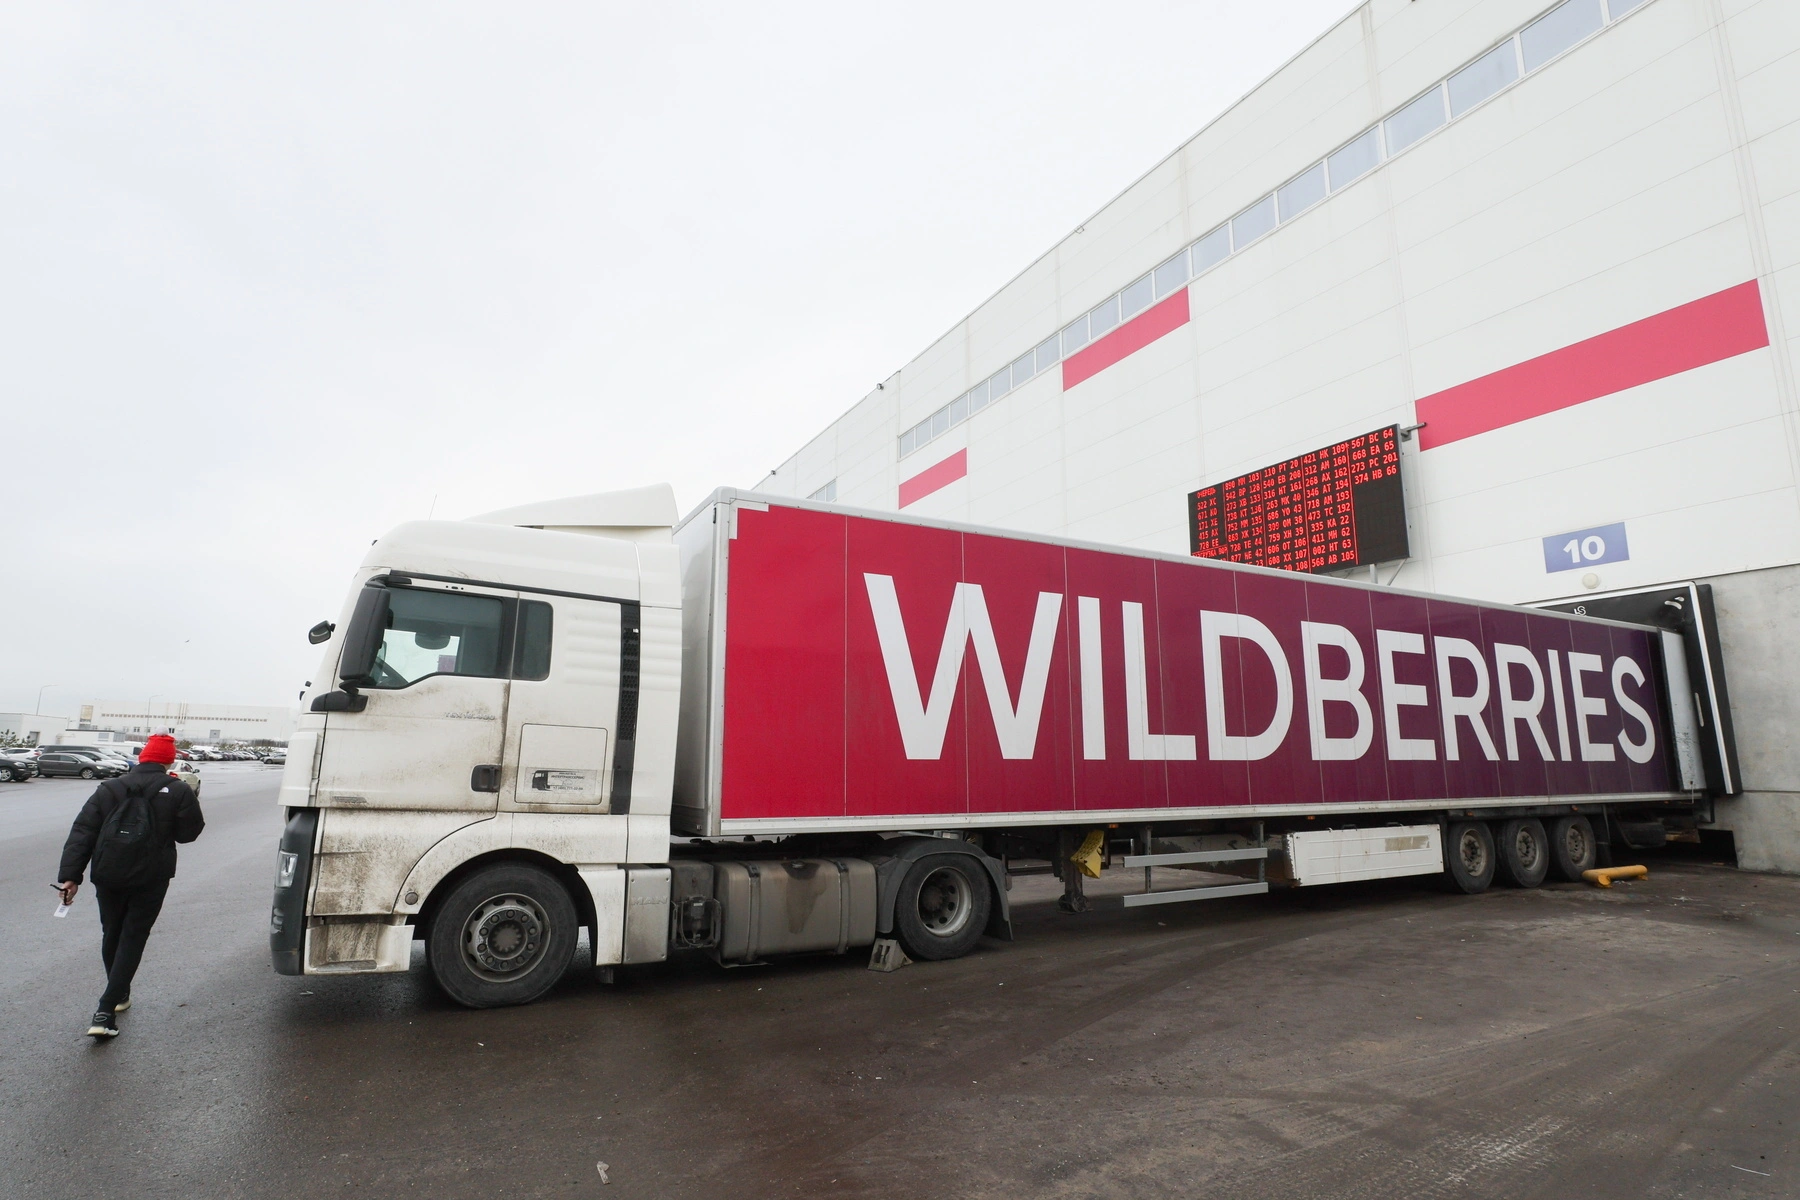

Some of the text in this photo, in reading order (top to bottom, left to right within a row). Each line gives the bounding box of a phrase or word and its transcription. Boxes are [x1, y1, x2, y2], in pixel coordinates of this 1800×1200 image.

[1352, 437, 1364, 449] 567
[1383, 428, 1393, 439] 64
[1304, 454, 1316, 464] 421
[1352, 449, 1366, 460] 668
[1384, 441, 1394, 451] 65
[1264, 467, 1276, 478] 110
[1290, 460, 1298, 469] 20
[1305, 465, 1317, 476] 312
[1334, 455, 1347, 466] 160
[1351, 462, 1365, 473] 273
[1383, 452, 1398, 464] 201
[1248, 472, 1259, 483] 103
[1263, 478, 1274, 489] 540
[1290, 470, 1301, 481] 208
[1305, 477, 1318, 487] 268
[1334, 467, 1348, 478] 162
[1355, 472, 1368, 484] 374
[1387, 465, 1396, 475] 66
[1226, 491, 1236, 501] 542
[1249, 483, 1260, 494] 128
[1264, 489, 1275, 500] 316
[1290, 481, 1302, 492] 161
[1307, 488, 1319, 498] 346
[1335, 479, 1349, 489] 194
[1198, 501, 1207, 510] 522
[1226, 502, 1236, 511] 273
[1250, 494, 1261, 504] 133
[1266, 500, 1278, 510] 263
[1293, 493, 1301, 502] 40
[1307, 499, 1320, 510] 718
[1336, 491, 1350, 502] 193
[1198, 511, 1208, 520] 671
[1250, 504, 1262, 515] 136
[1268, 510, 1279, 521] 686
[1294, 504, 1302, 513] 43
[1308, 511, 1321, 521] 473
[1337, 503, 1351, 513] 192
[1199, 521, 1208, 530] 171
[1228, 522, 1238, 532] 752
[1251, 515, 1262, 526] 135
[1294, 515, 1303, 524] 38
[1311, 522, 1324, 532] 335
[1340, 515, 1349, 525] 22
[1199, 531, 1208, 540] 415
[1252, 526, 1262, 536] 134
[1269, 533, 1280, 543] 759
[1295, 527, 1303, 536] 39
[1312, 533, 1325, 543] 411
[1341, 527, 1350, 536] 62
[1199, 541, 1209, 550] 728
[1255, 537, 1262, 546] 44
[1268, 544, 1279, 554] 606
[1294, 538, 1306, 548] 106
[1312, 545, 1325, 555] 002
[1342, 539, 1352, 549] 63
[1564, 536, 1606, 563] 10
[1255, 548, 1262, 557] 42
[1295, 549, 1307, 559] 107
[1312, 557, 1325, 567] 568
[1341, 550, 1354, 561] 105
[1296, 560, 1308, 570] 108
[863, 572, 1655, 765] WILDBERRIES
